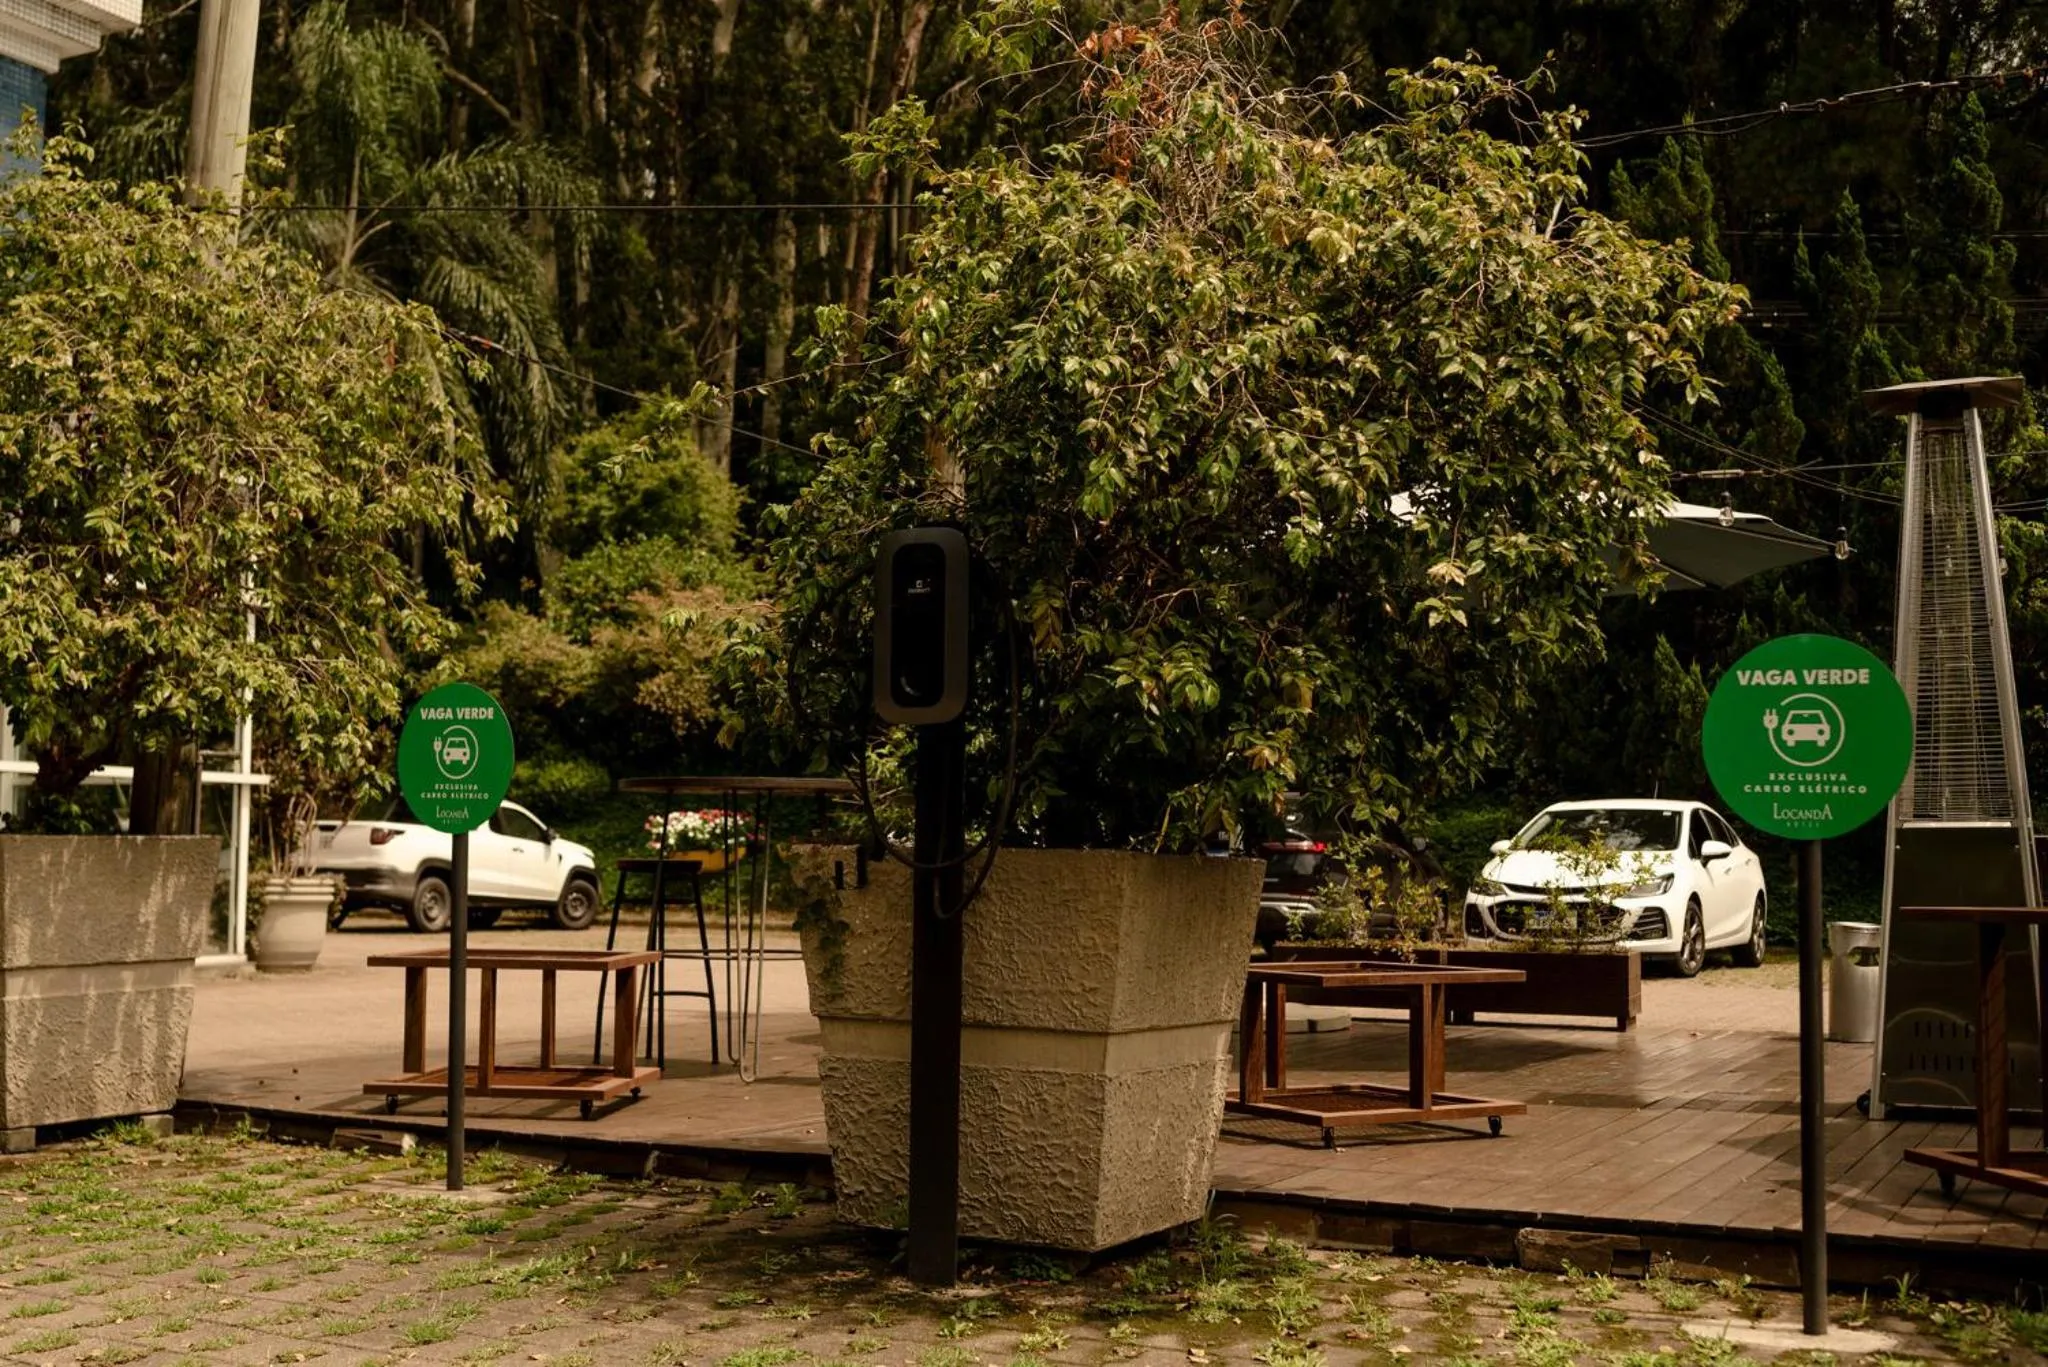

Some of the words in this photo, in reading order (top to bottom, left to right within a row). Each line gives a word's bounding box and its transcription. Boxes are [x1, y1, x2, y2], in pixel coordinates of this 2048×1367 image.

[1736, 669, 1798, 686] VAGA
[1803, 668, 1870, 685] VERDE
[420, 707, 453, 720] VAGA
[456, 707, 494, 720] VERDE
[1769, 772, 1847, 781] EXCLUSIVA
[1743, 784, 1791, 793] CARRO
[1799, 783, 1867, 794] ELÉTRICO
